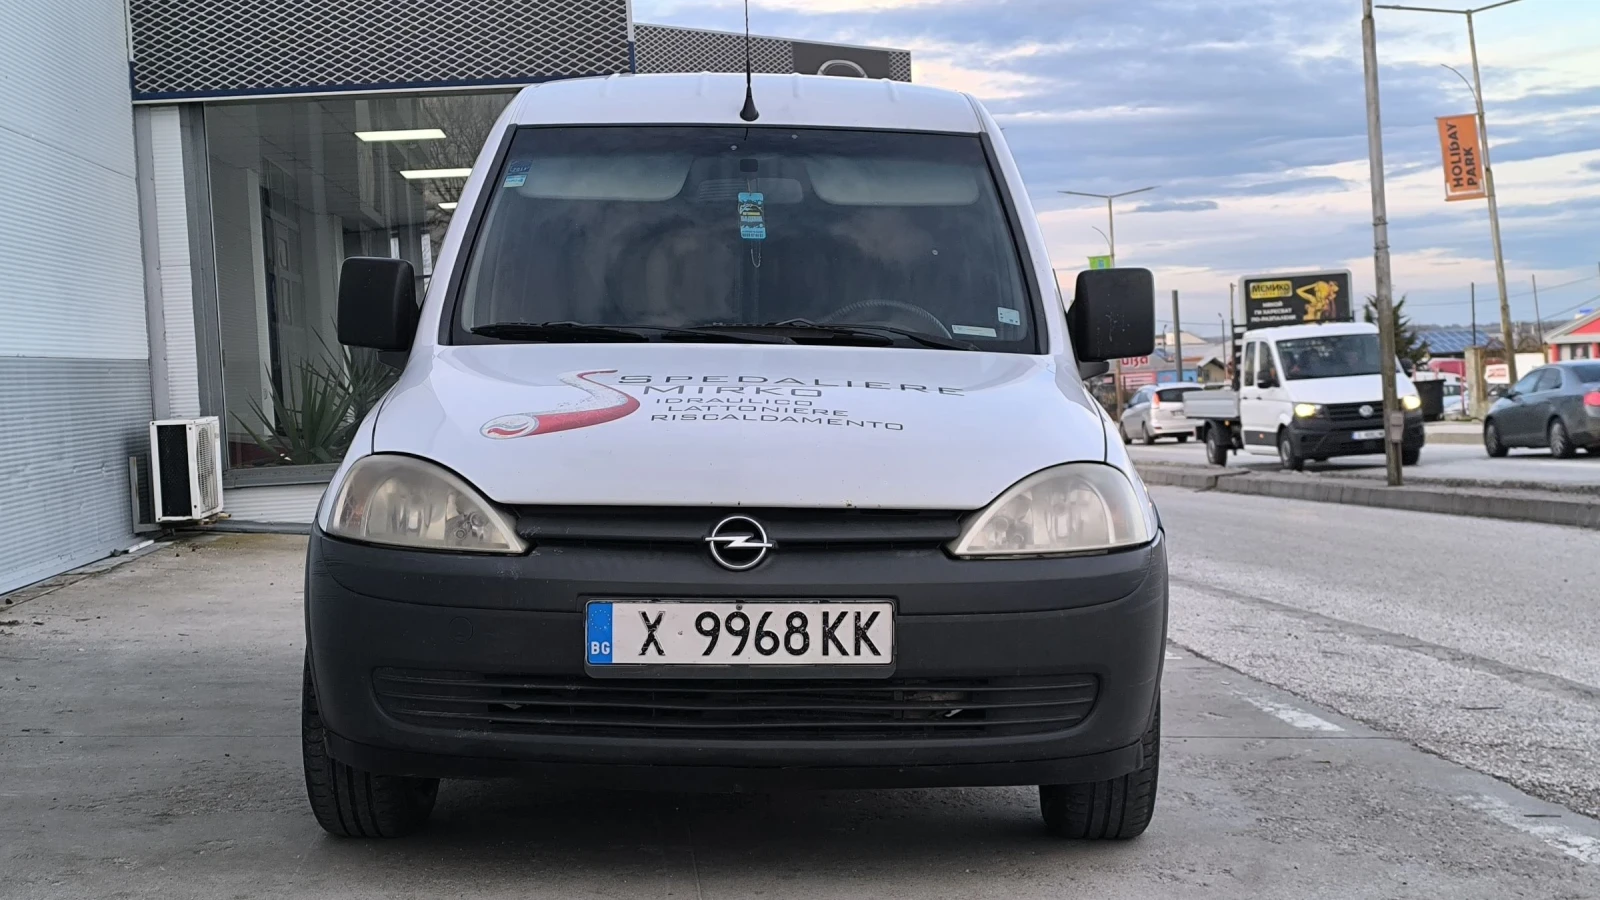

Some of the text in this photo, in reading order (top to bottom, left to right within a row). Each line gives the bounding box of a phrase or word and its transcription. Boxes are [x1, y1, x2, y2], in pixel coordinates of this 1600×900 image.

[1446, 121, 1463, 187] HOLIDAY
[1463, 146, 1477, 186] PARK
[618, 375, 965, 396] SPEDALIERE
[643, 385, 822, 397] MIRKO
[656, 397, 812, 406] IDRAULICO
[668, 405, 848, 416] LATTONIERE
[651, 414, 903, 430] RISCALDAMENTO
[590, 641, 610, 654] BG
